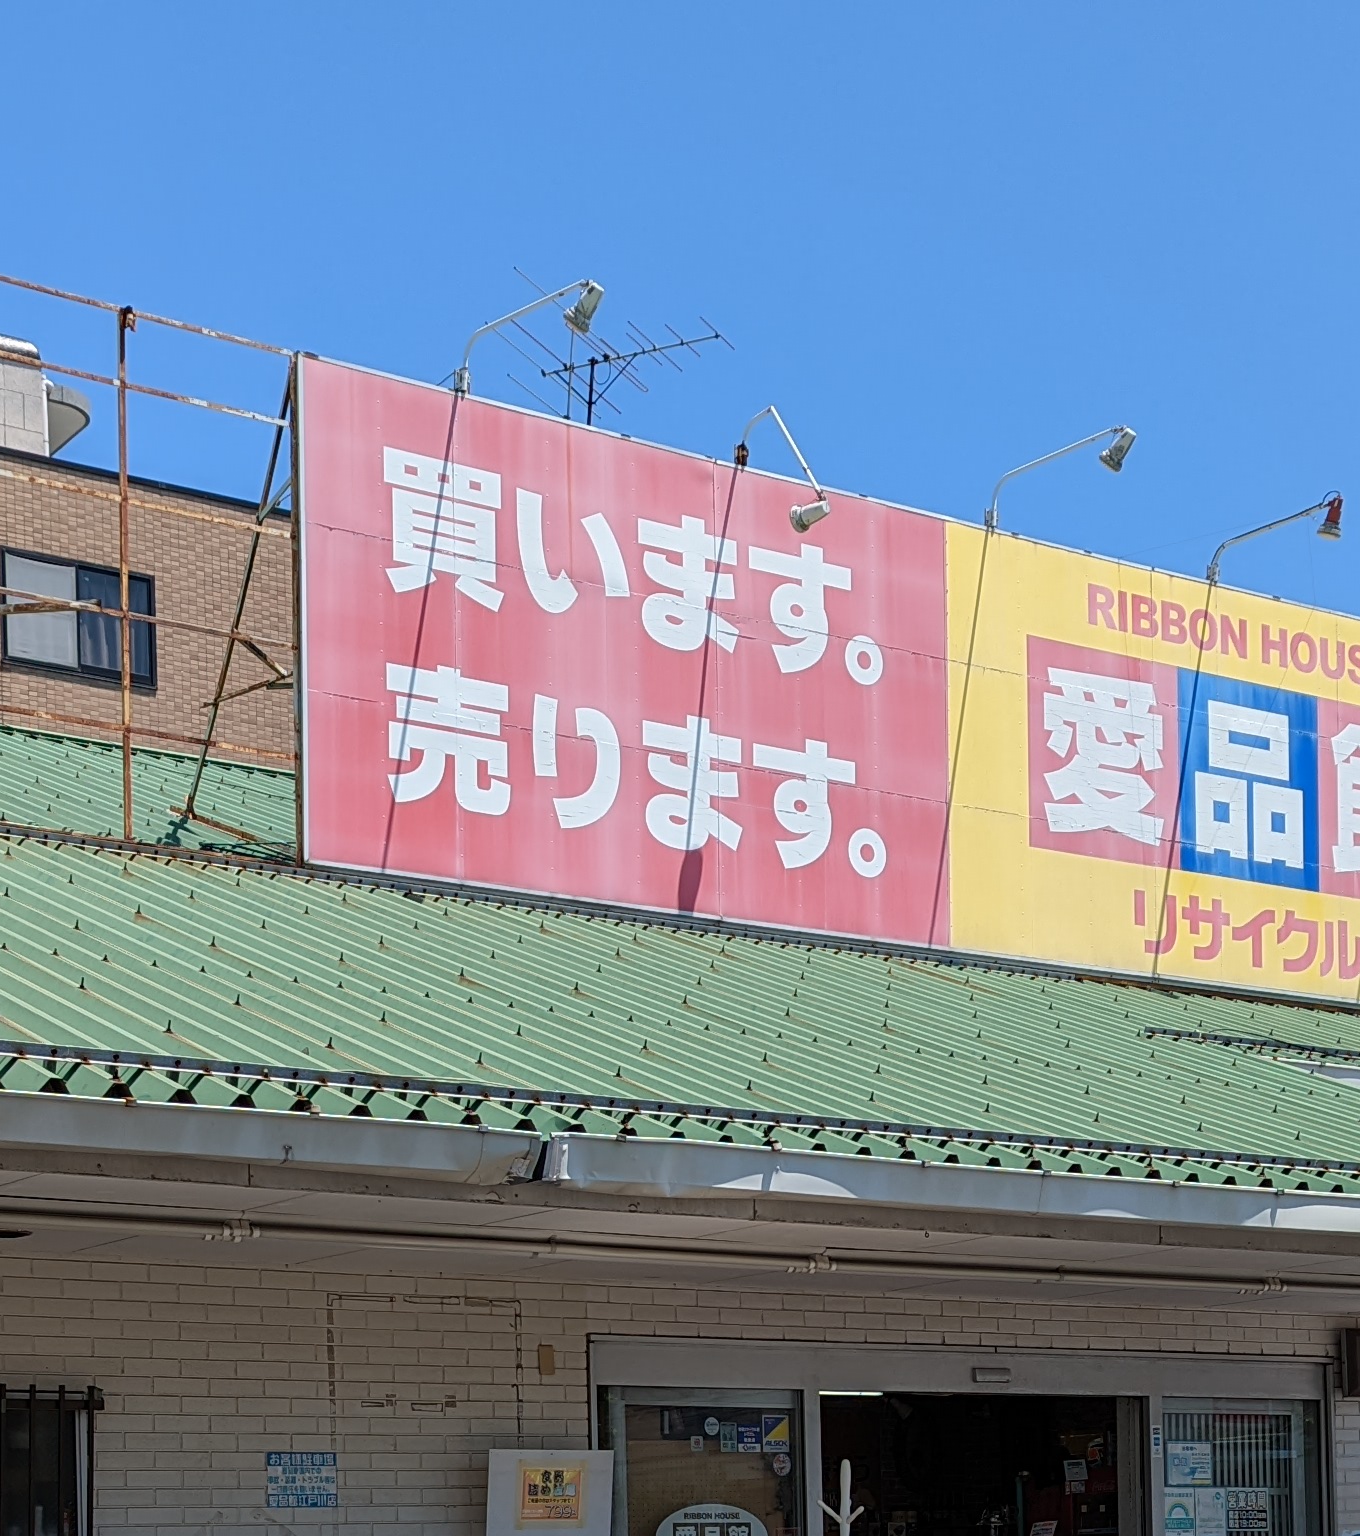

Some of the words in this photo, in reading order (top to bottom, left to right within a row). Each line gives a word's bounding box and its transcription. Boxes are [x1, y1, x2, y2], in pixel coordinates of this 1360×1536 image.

[382, 445, 886, 687] 買います。
[1086, 583, 1248, 658] RIBBON
[385, 662, 888, 879] 売ります。
[683, 1512, 712, 1520] RIBBON
[714, 1512, 740, 1520] HOUSE
